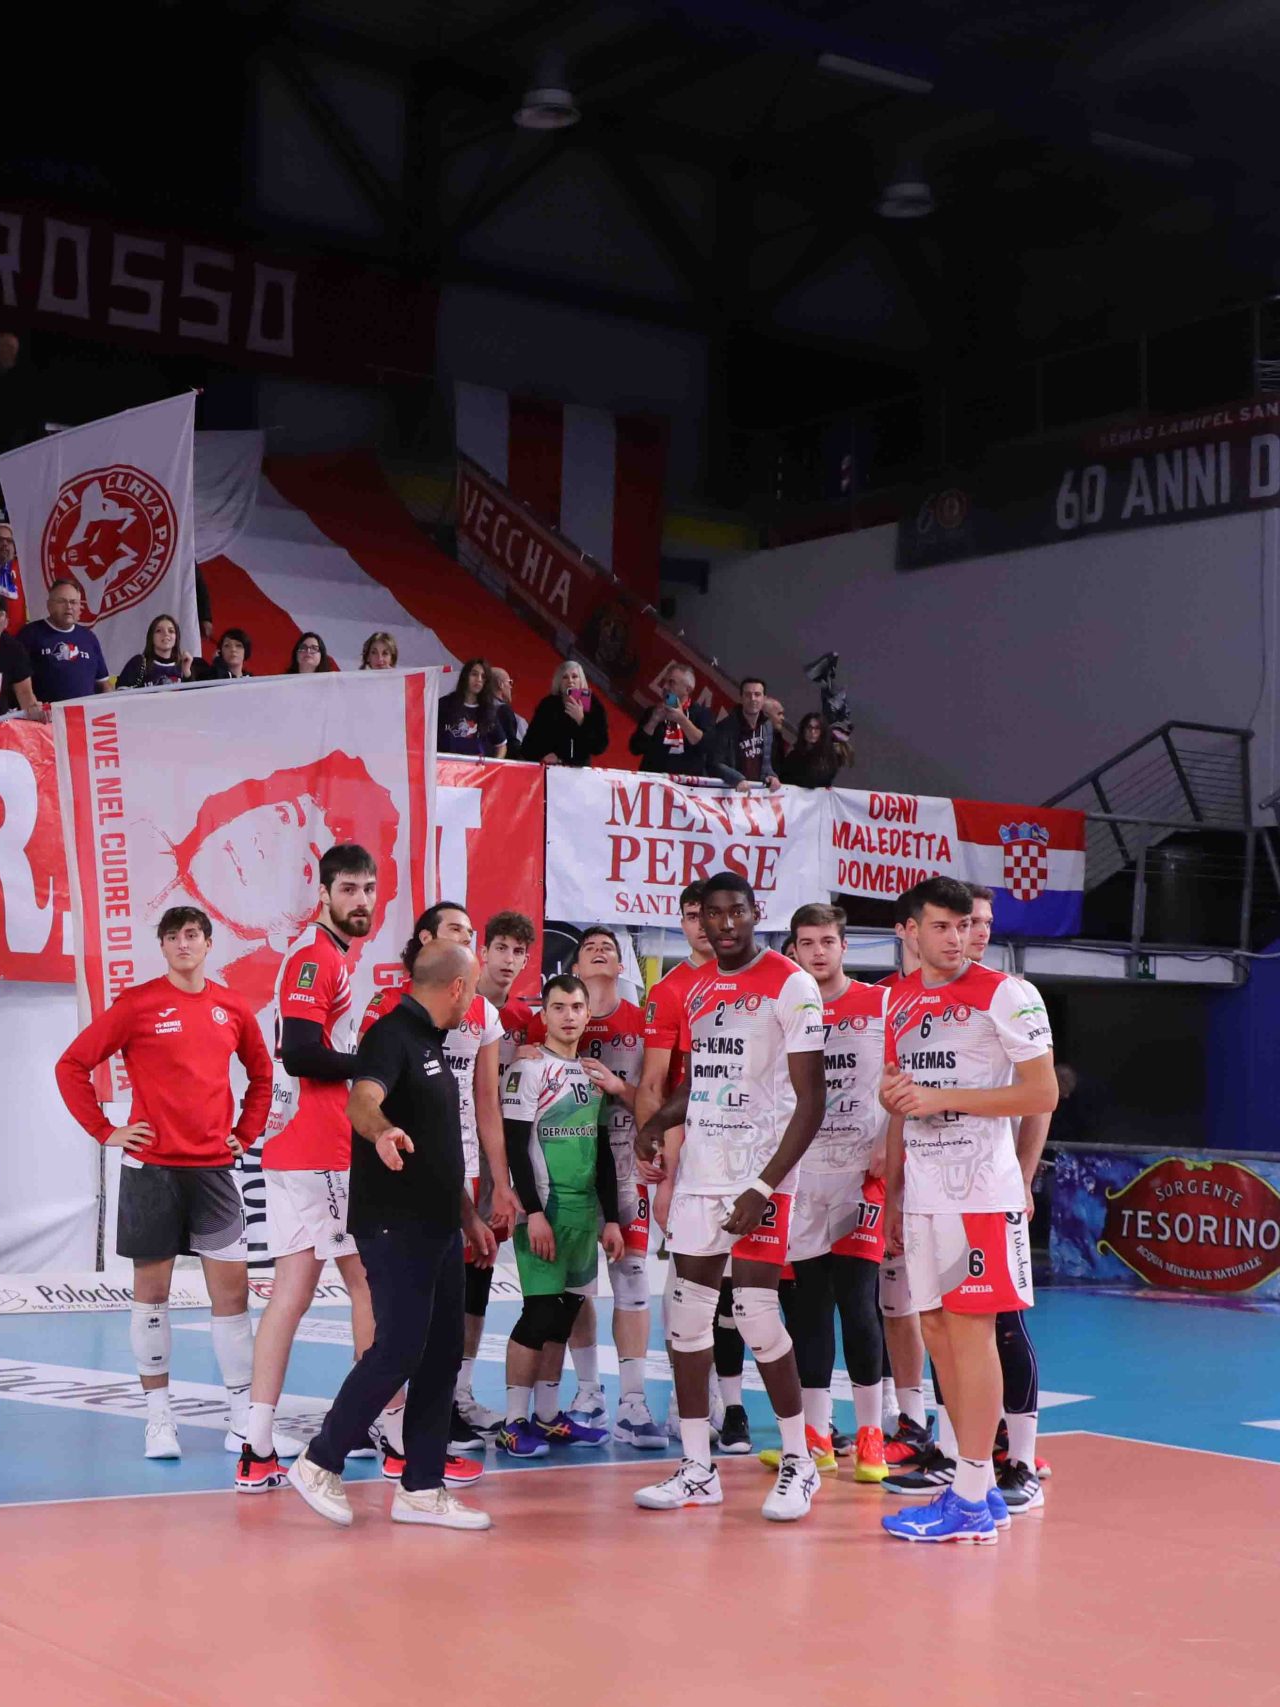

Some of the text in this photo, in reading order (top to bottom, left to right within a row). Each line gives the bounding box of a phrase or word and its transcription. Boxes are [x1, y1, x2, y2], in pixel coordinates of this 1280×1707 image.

[1055, 464, 1107, 530] 60
[1121, 441, 1231, 520] ANNI
[105, 474, 168, 609] CURVA PARENTI
[463, 480, 572, 616] VECCHIA
[91, 712, 120, 770] VIVE
[96, 777, 126, 826] NEL
[605, 779, 788, 838] MENTI
[869, 793, 918, 825] OGNI
[832, 819, 952, 863] MALEDETTA
[100, 833, 131, 921] CUORE
[605, 834, 782, 891] PERSE
[106, 925, 134, 952] DI
[714, 1000, 726, 1027] 2
[920, 1012, 933, 1039] 6
[590, 1039, 602, 1059] 8
[911, 1050, 957, 1070] KEMAS
[570, 1082, 589, 1104] 16
[727, 1092, 750, 1107] LF
[839, 1100, 860, 1113] LF
[614, 1115, 631, 1128] LF
[1154, 1179, 1244, 1209] SORGENTE
[637, 1199, 647, 1220] 8
[760, 1201, 777, 1228] 2
[857, 1202, 881, 1229] 17
[1121, 1209, 1280, 1251] TESORINO
[968, 1248, 985, 1279] 6
[1135, 1244, 1263, 1281] ACQUA MINERALE NATURALE
